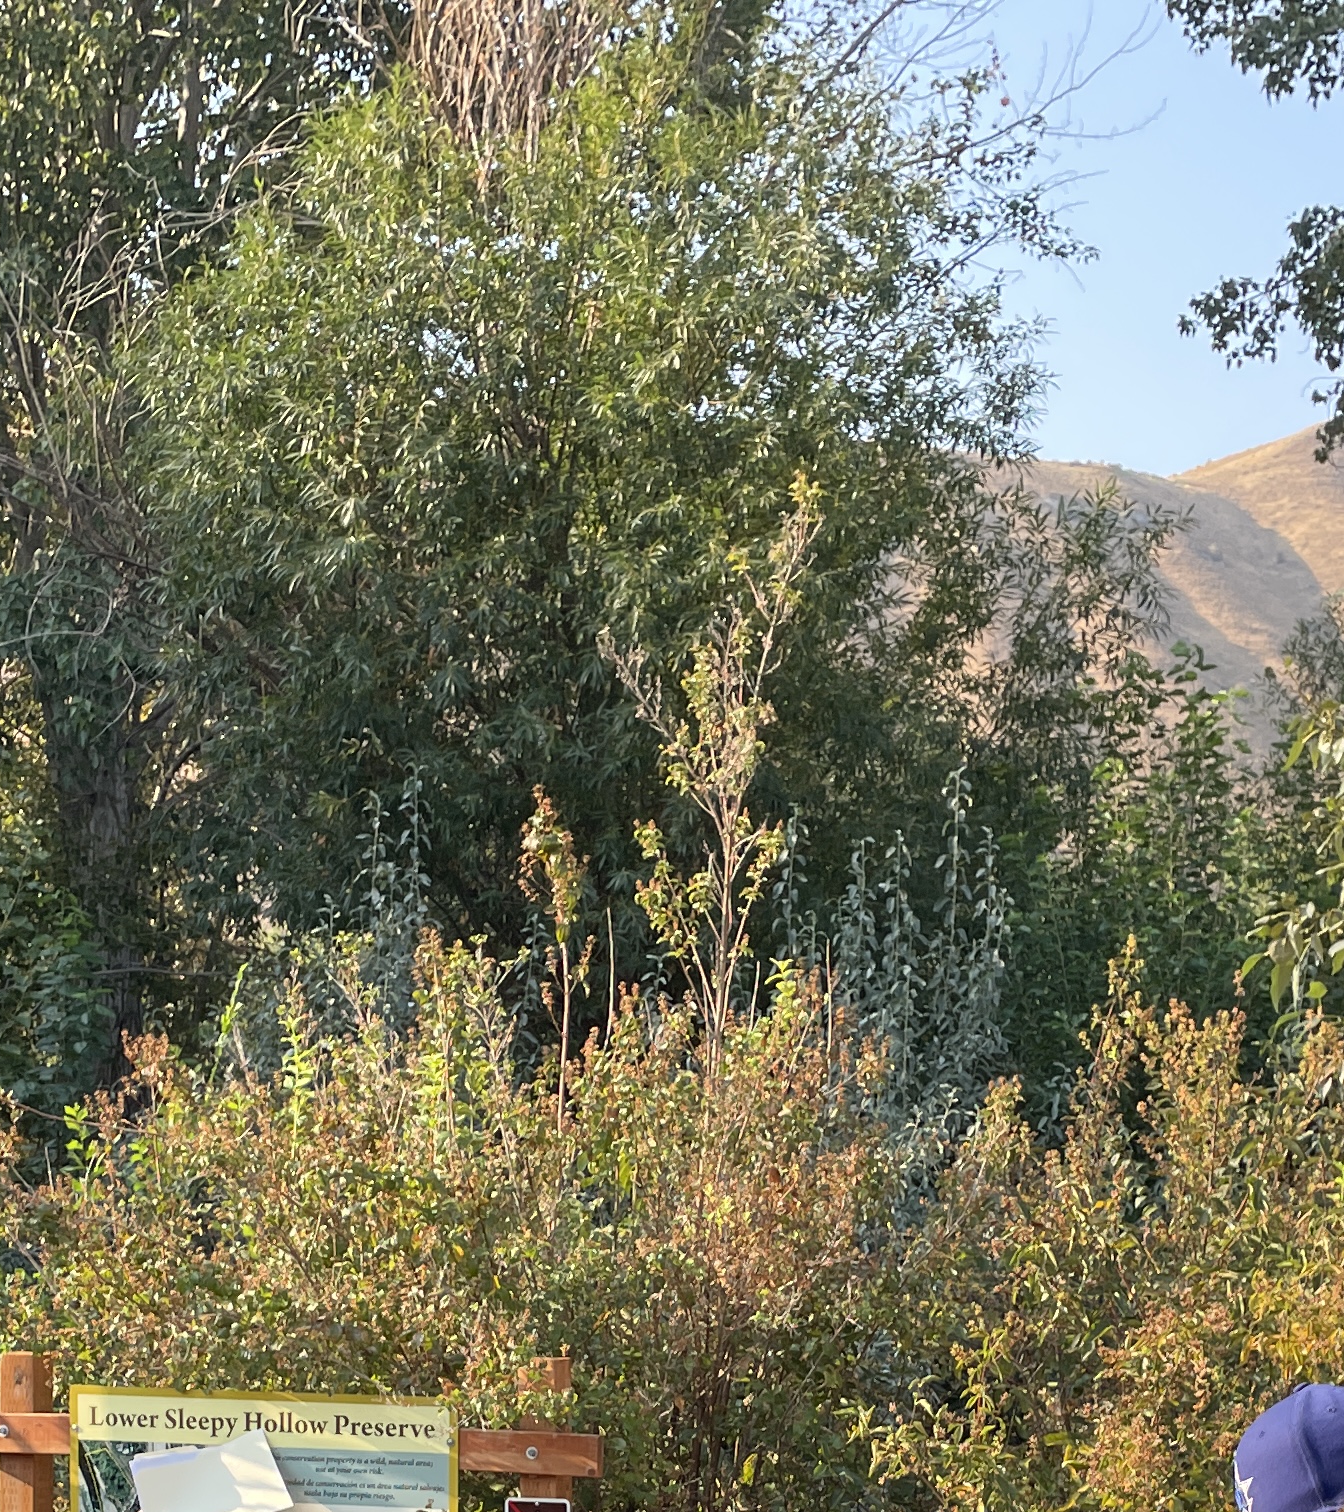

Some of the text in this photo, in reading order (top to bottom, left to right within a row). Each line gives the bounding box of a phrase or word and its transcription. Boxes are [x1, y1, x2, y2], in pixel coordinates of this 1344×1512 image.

[89, 1406, 436, 1439] Lower Sleepy Hollow Preserve
